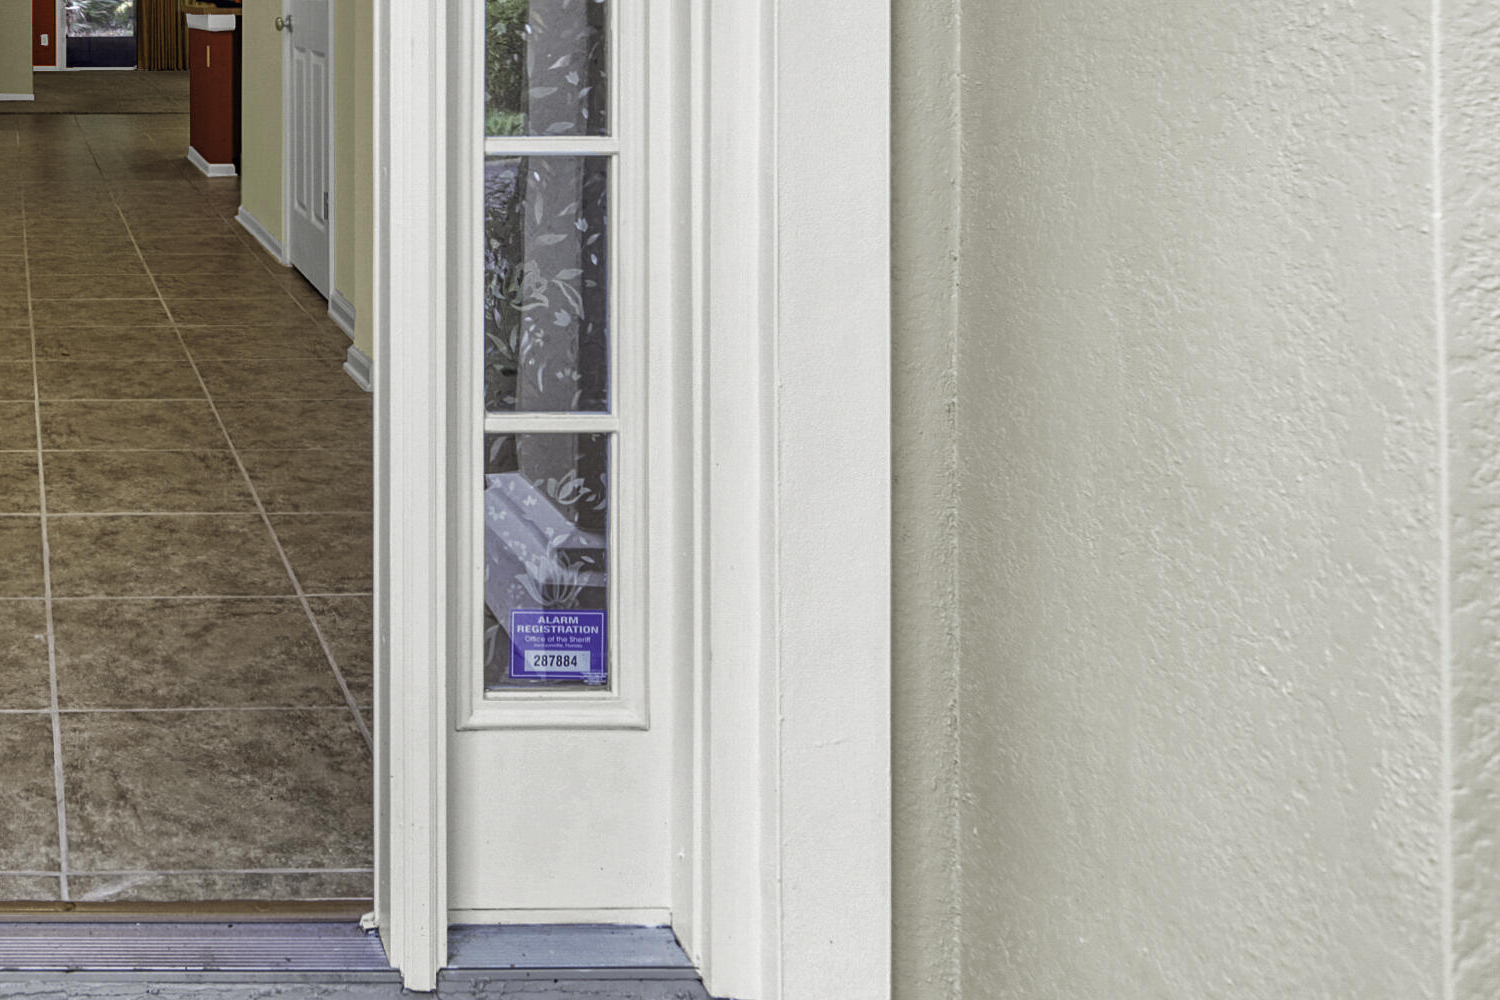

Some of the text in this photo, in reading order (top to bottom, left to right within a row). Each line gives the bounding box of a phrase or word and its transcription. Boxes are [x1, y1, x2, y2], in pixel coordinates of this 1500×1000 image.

[538, 616, 579, 624] ALARM
[516, 625, 599, 634] REGISTRATION
[524, 635, 591, 643] Office of the Sheriff
[533, 654, 578, 667] 287884
